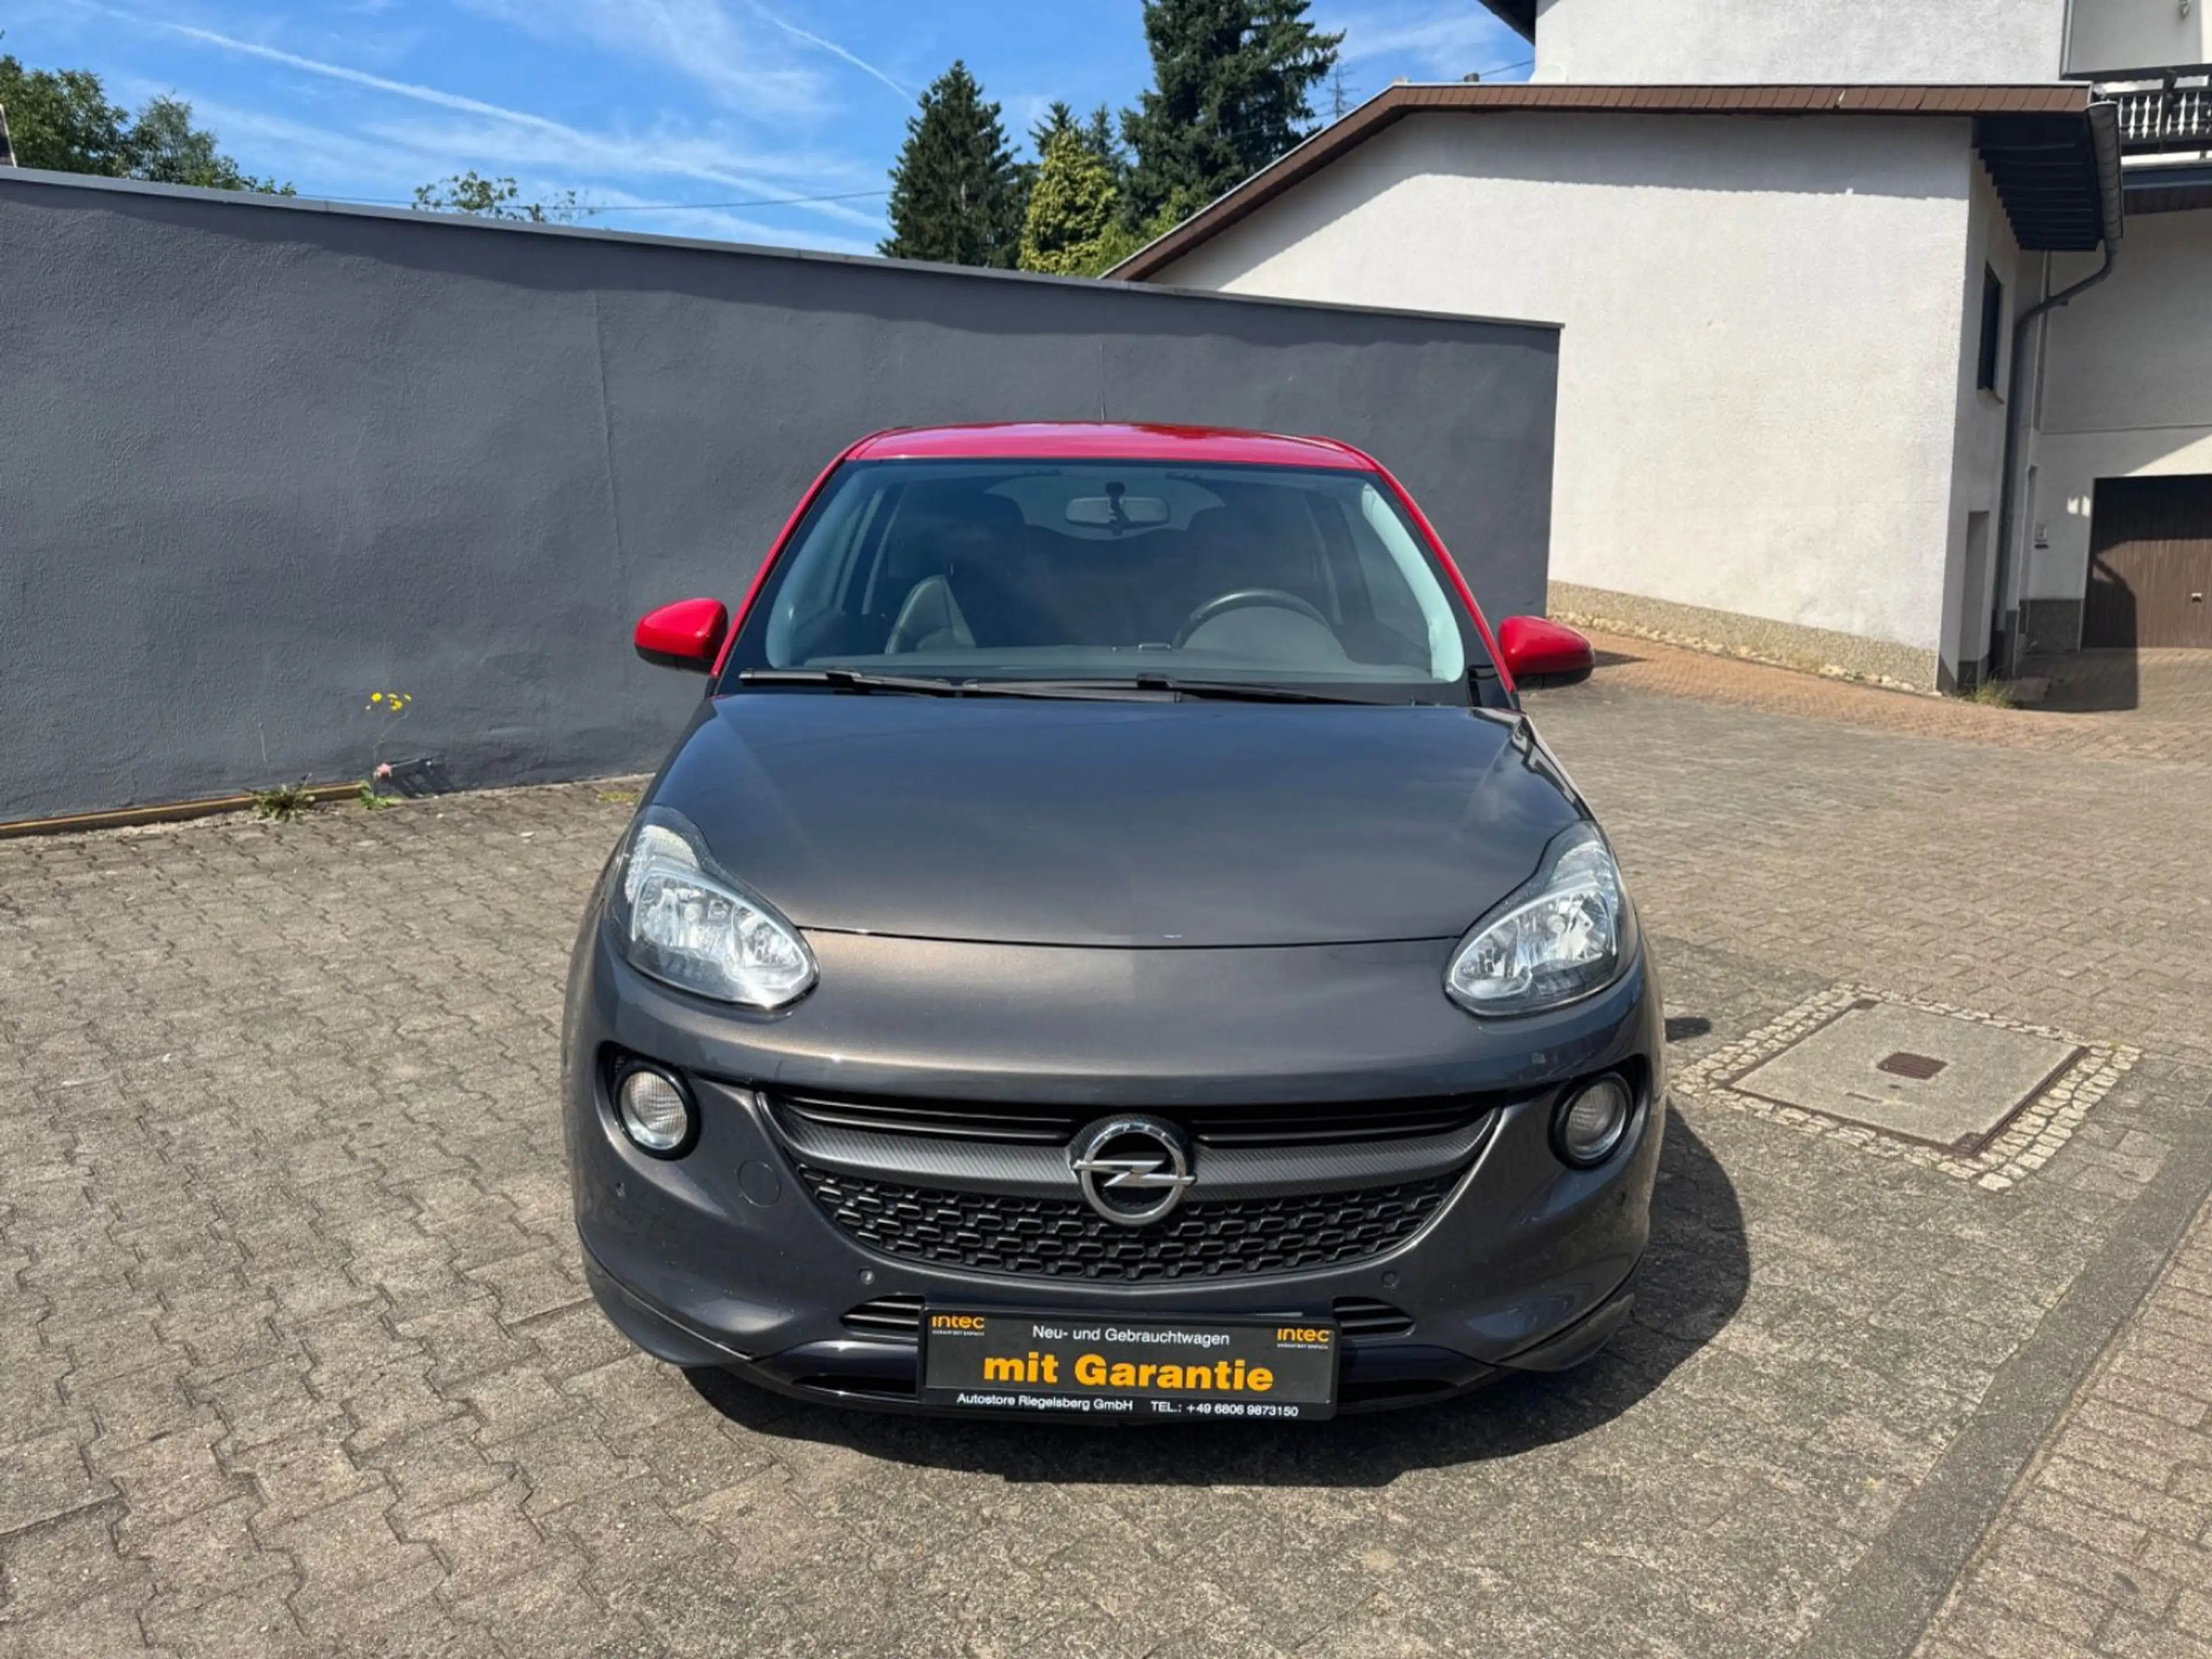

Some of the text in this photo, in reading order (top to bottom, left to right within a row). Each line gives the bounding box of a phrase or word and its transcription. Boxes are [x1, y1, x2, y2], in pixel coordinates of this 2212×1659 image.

[931, 1316, 985, 1329] intec
[1032, 1325, 1230, 1348] Neu- und Gebrauchtwagen
[1277, 1327, 1330, 1342] intec
[983, 1351, 1275, 1392] mit Garantie
[956, 1393, 1134, 1411] Autostore Riegelsberg GmbH
[1150, 1401, 1182, 1412] TEL.:
[1186, 1403, 1211, 1414] +49
